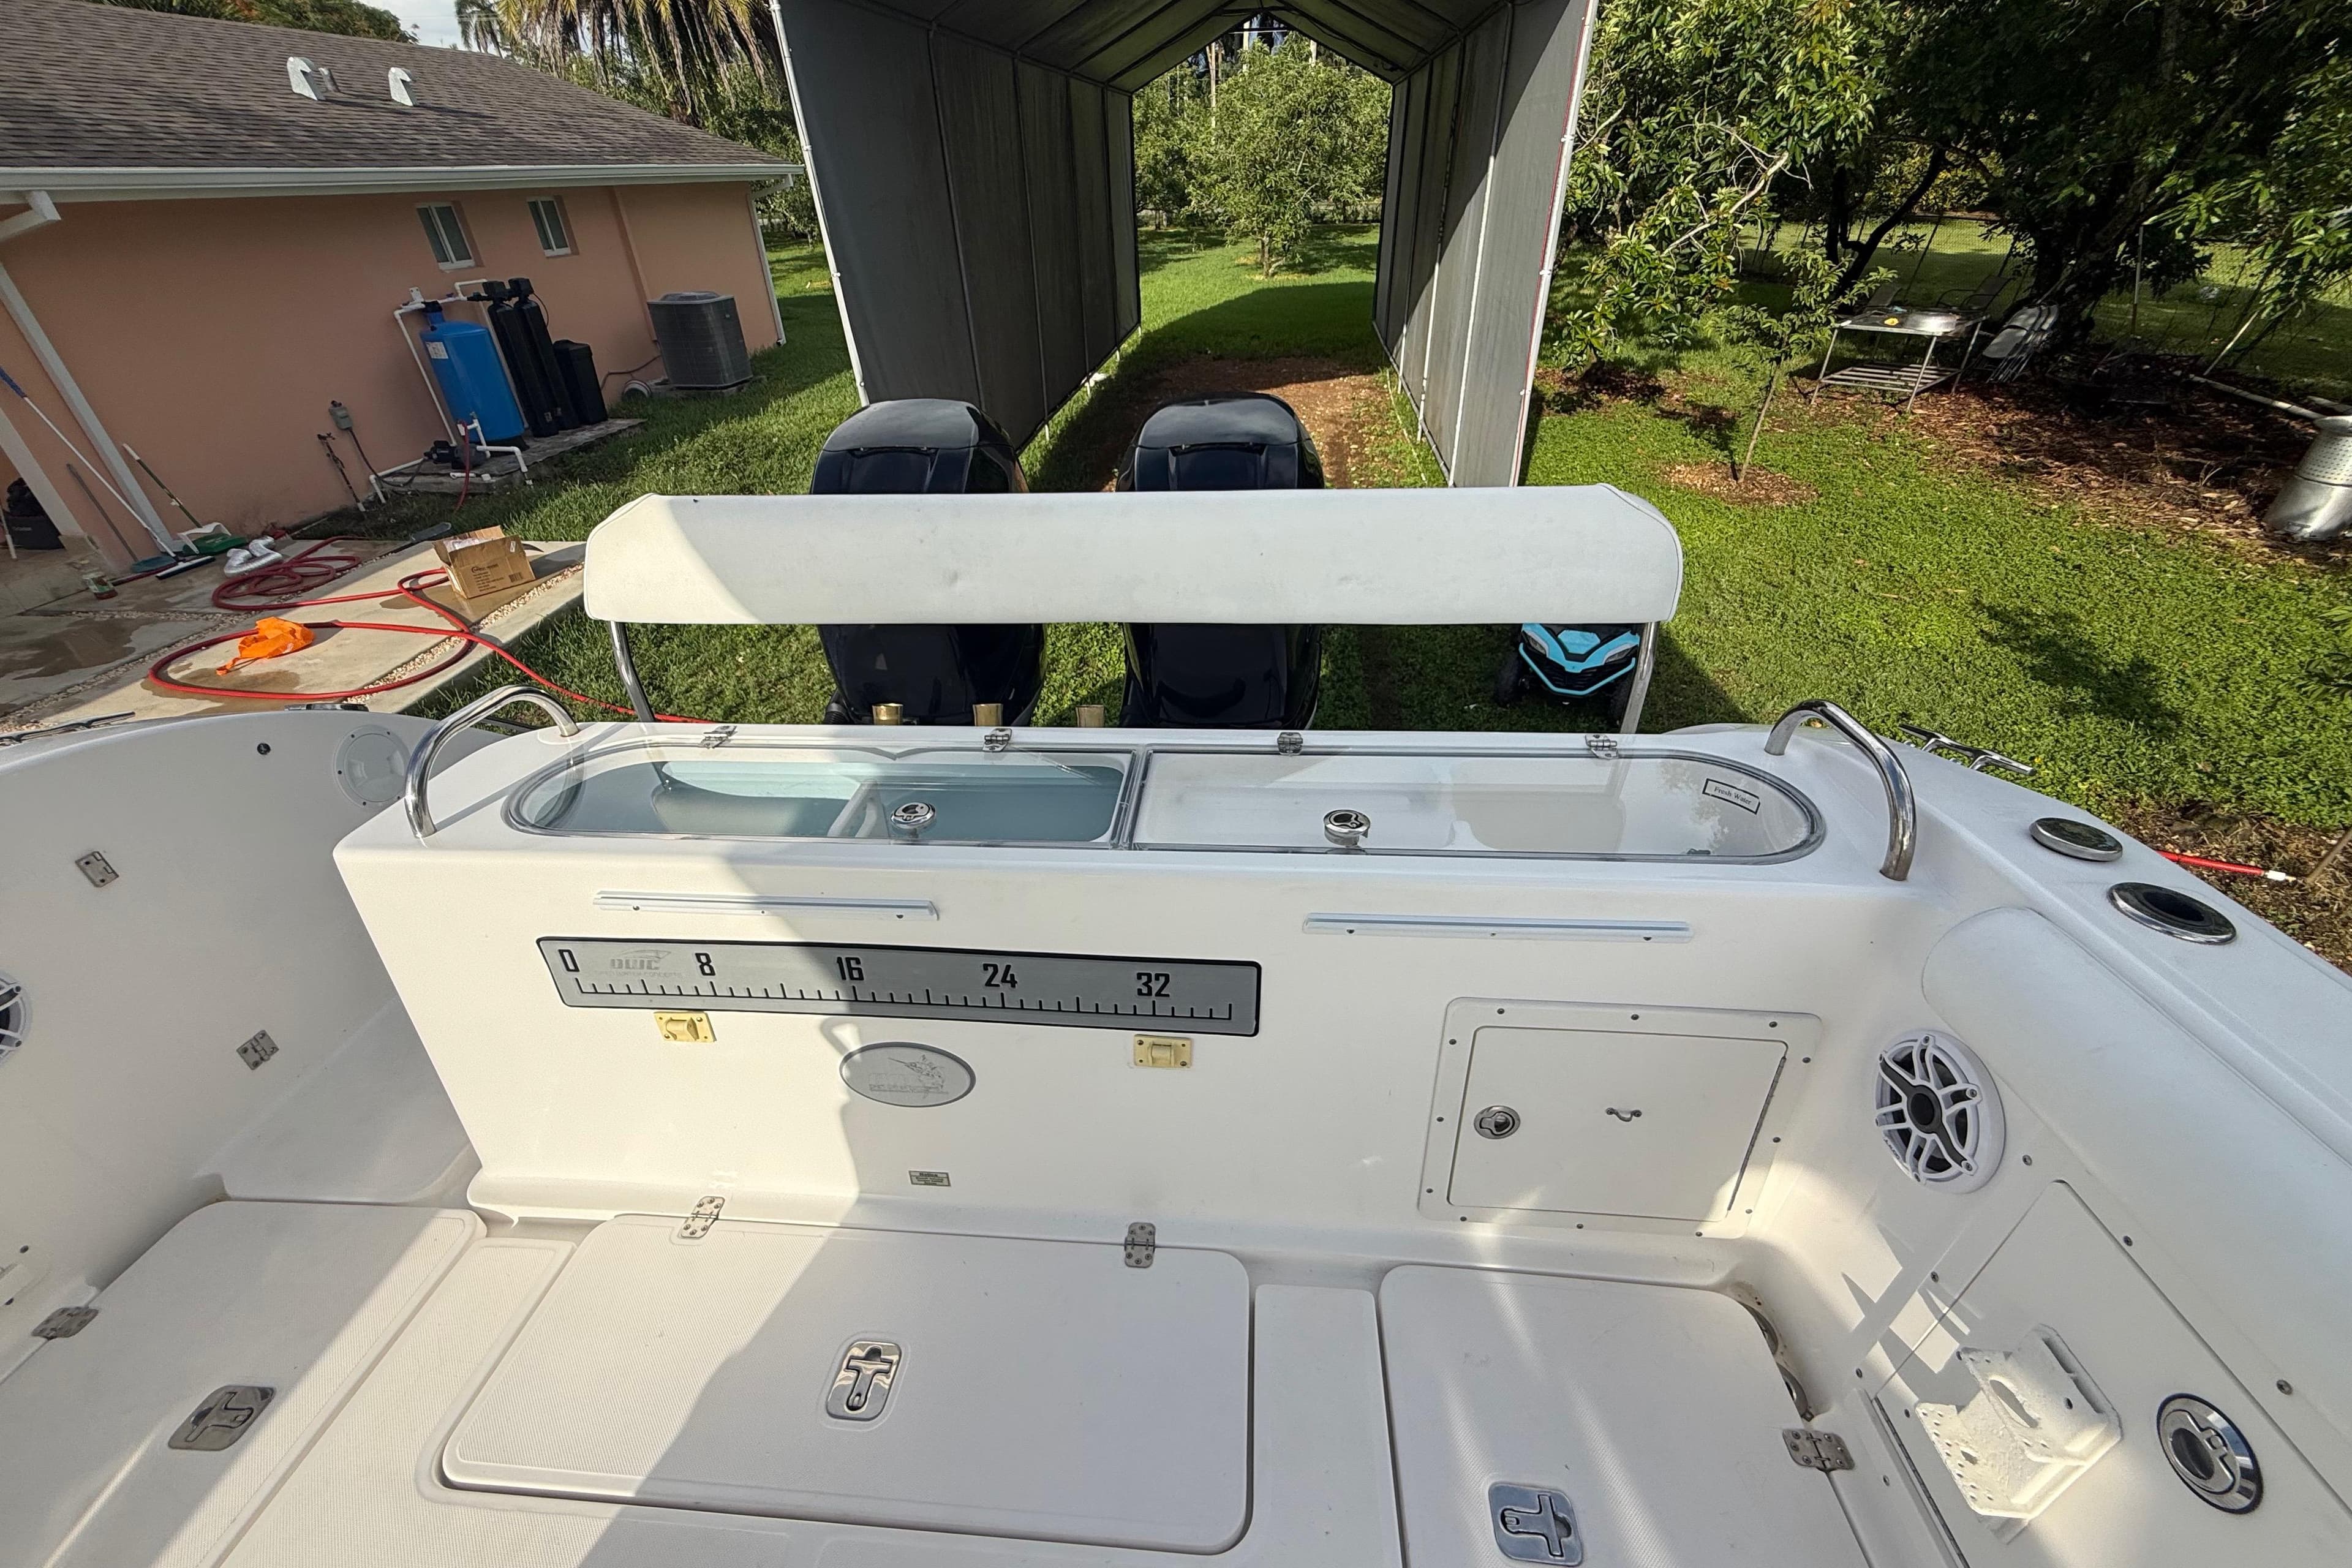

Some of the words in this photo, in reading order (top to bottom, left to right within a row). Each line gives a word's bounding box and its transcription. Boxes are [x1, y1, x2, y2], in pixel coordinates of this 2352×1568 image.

[1714, 786, 1732, 796] Fresh
[1735, 793, 1751, 804] Water
[695, 952, 716, 976] 8
[836, 956, 864, 981] 16
[982, 963, 1018, 989] 24
[1136, 971, 1170, 998] 32
